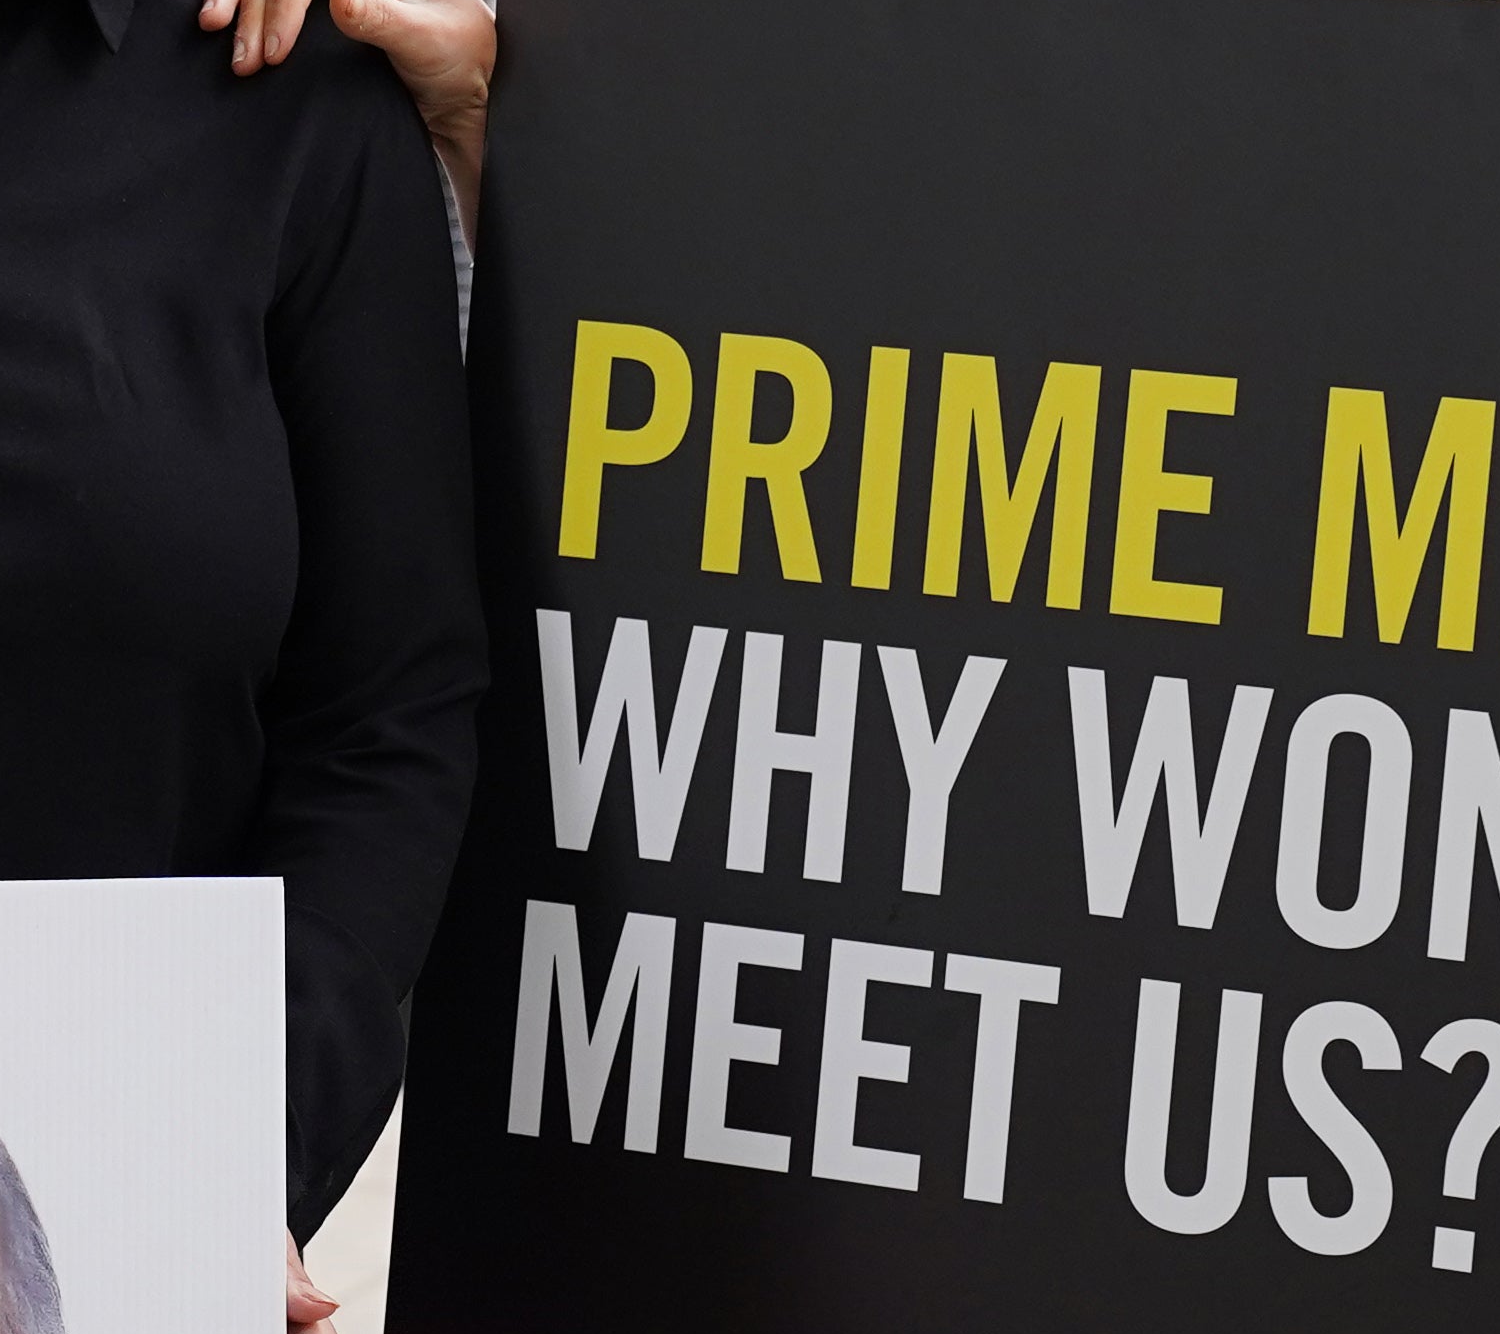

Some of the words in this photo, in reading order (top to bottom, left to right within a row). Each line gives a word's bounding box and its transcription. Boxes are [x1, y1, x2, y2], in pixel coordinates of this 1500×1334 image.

[559, 320, 1237, 626] PRIME
[536, 609, 1007, 896] WHY
[508, 900, 1061, 1205] MEET
